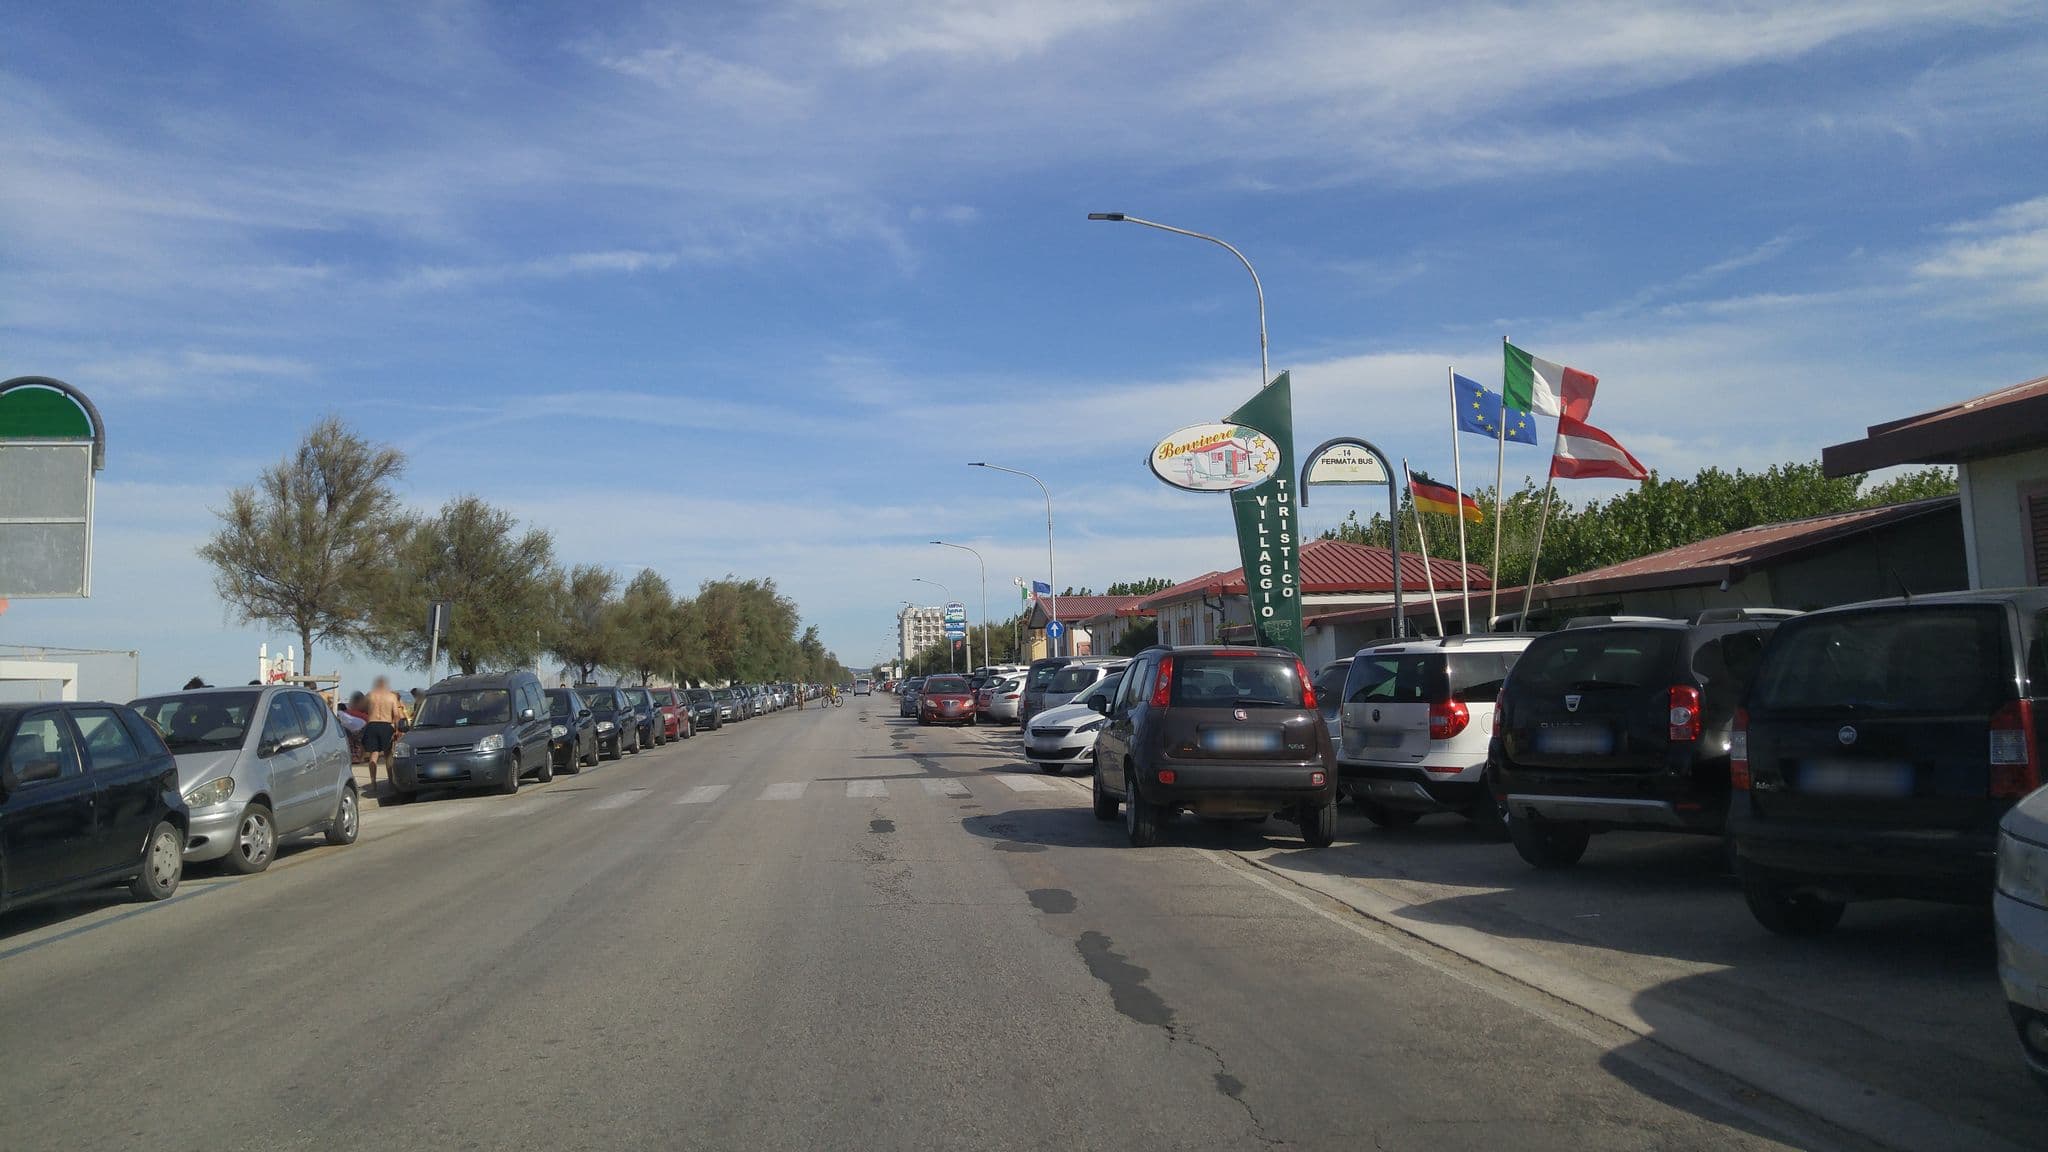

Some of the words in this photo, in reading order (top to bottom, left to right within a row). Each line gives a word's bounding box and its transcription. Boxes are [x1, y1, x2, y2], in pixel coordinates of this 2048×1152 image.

[1158, 429, 1233, 460] Benvivere
[1343, 449, 1351, 457] 14
[1256, 495, 1274, 617] VILLAGGIO
[1276, 479, 1294, 597] TURISTICO
